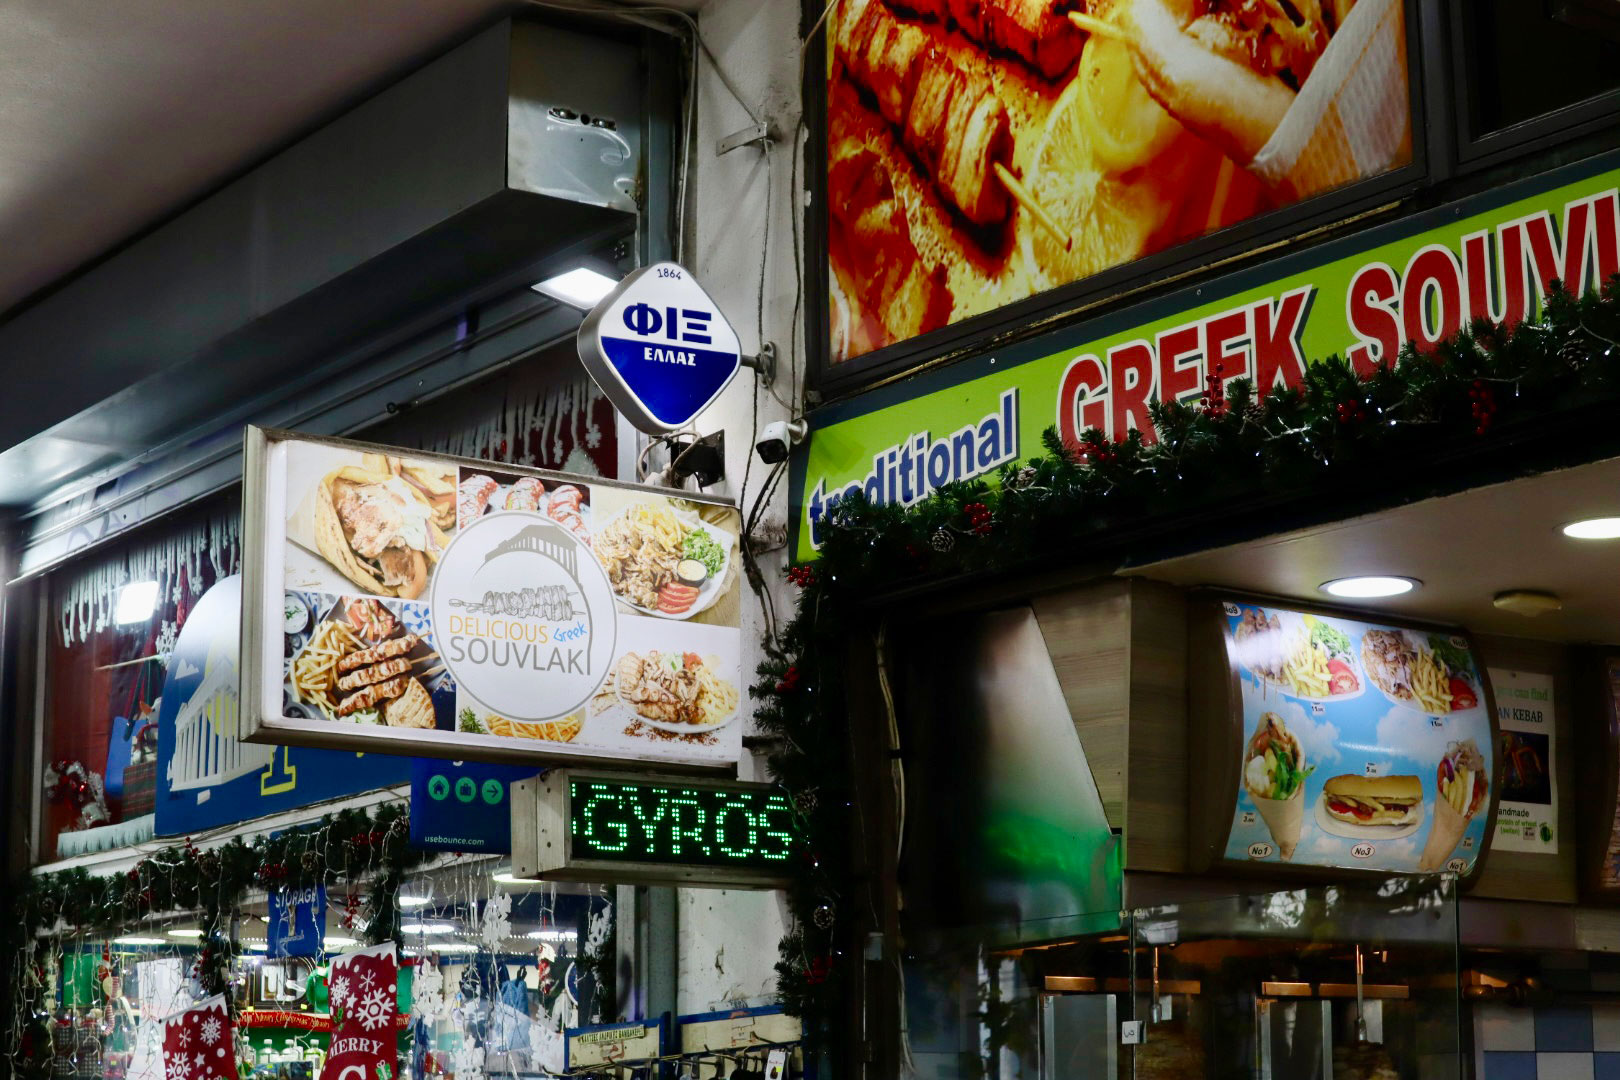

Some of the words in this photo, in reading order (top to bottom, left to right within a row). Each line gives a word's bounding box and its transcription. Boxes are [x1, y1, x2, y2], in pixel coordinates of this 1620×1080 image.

[657, 267, 681, 280] 1864
[622, 302, 712, 345] ΦΙΞ
[643, 347, 697, 366] ΕΛΛΑΣ
[1056, 284, 1314, 464] GREEK
[449, 615, 548, 644] DELICIOUS
[553, 621, 588, 642] Greek
[450, 635, 591, 676] SOUVLAKI
[1512, 708, 1543, 723] KEBAB
[1497, 808, 1529, 818] andmade
[584, 793, 793, 860] GYROS
[424, 835, 485, 846] usebounce.com
[1251, 846, 1269, 856] No1
[1354, 847, 1371, 857] No3
[328, 1037, 384, 1060] MERRY
